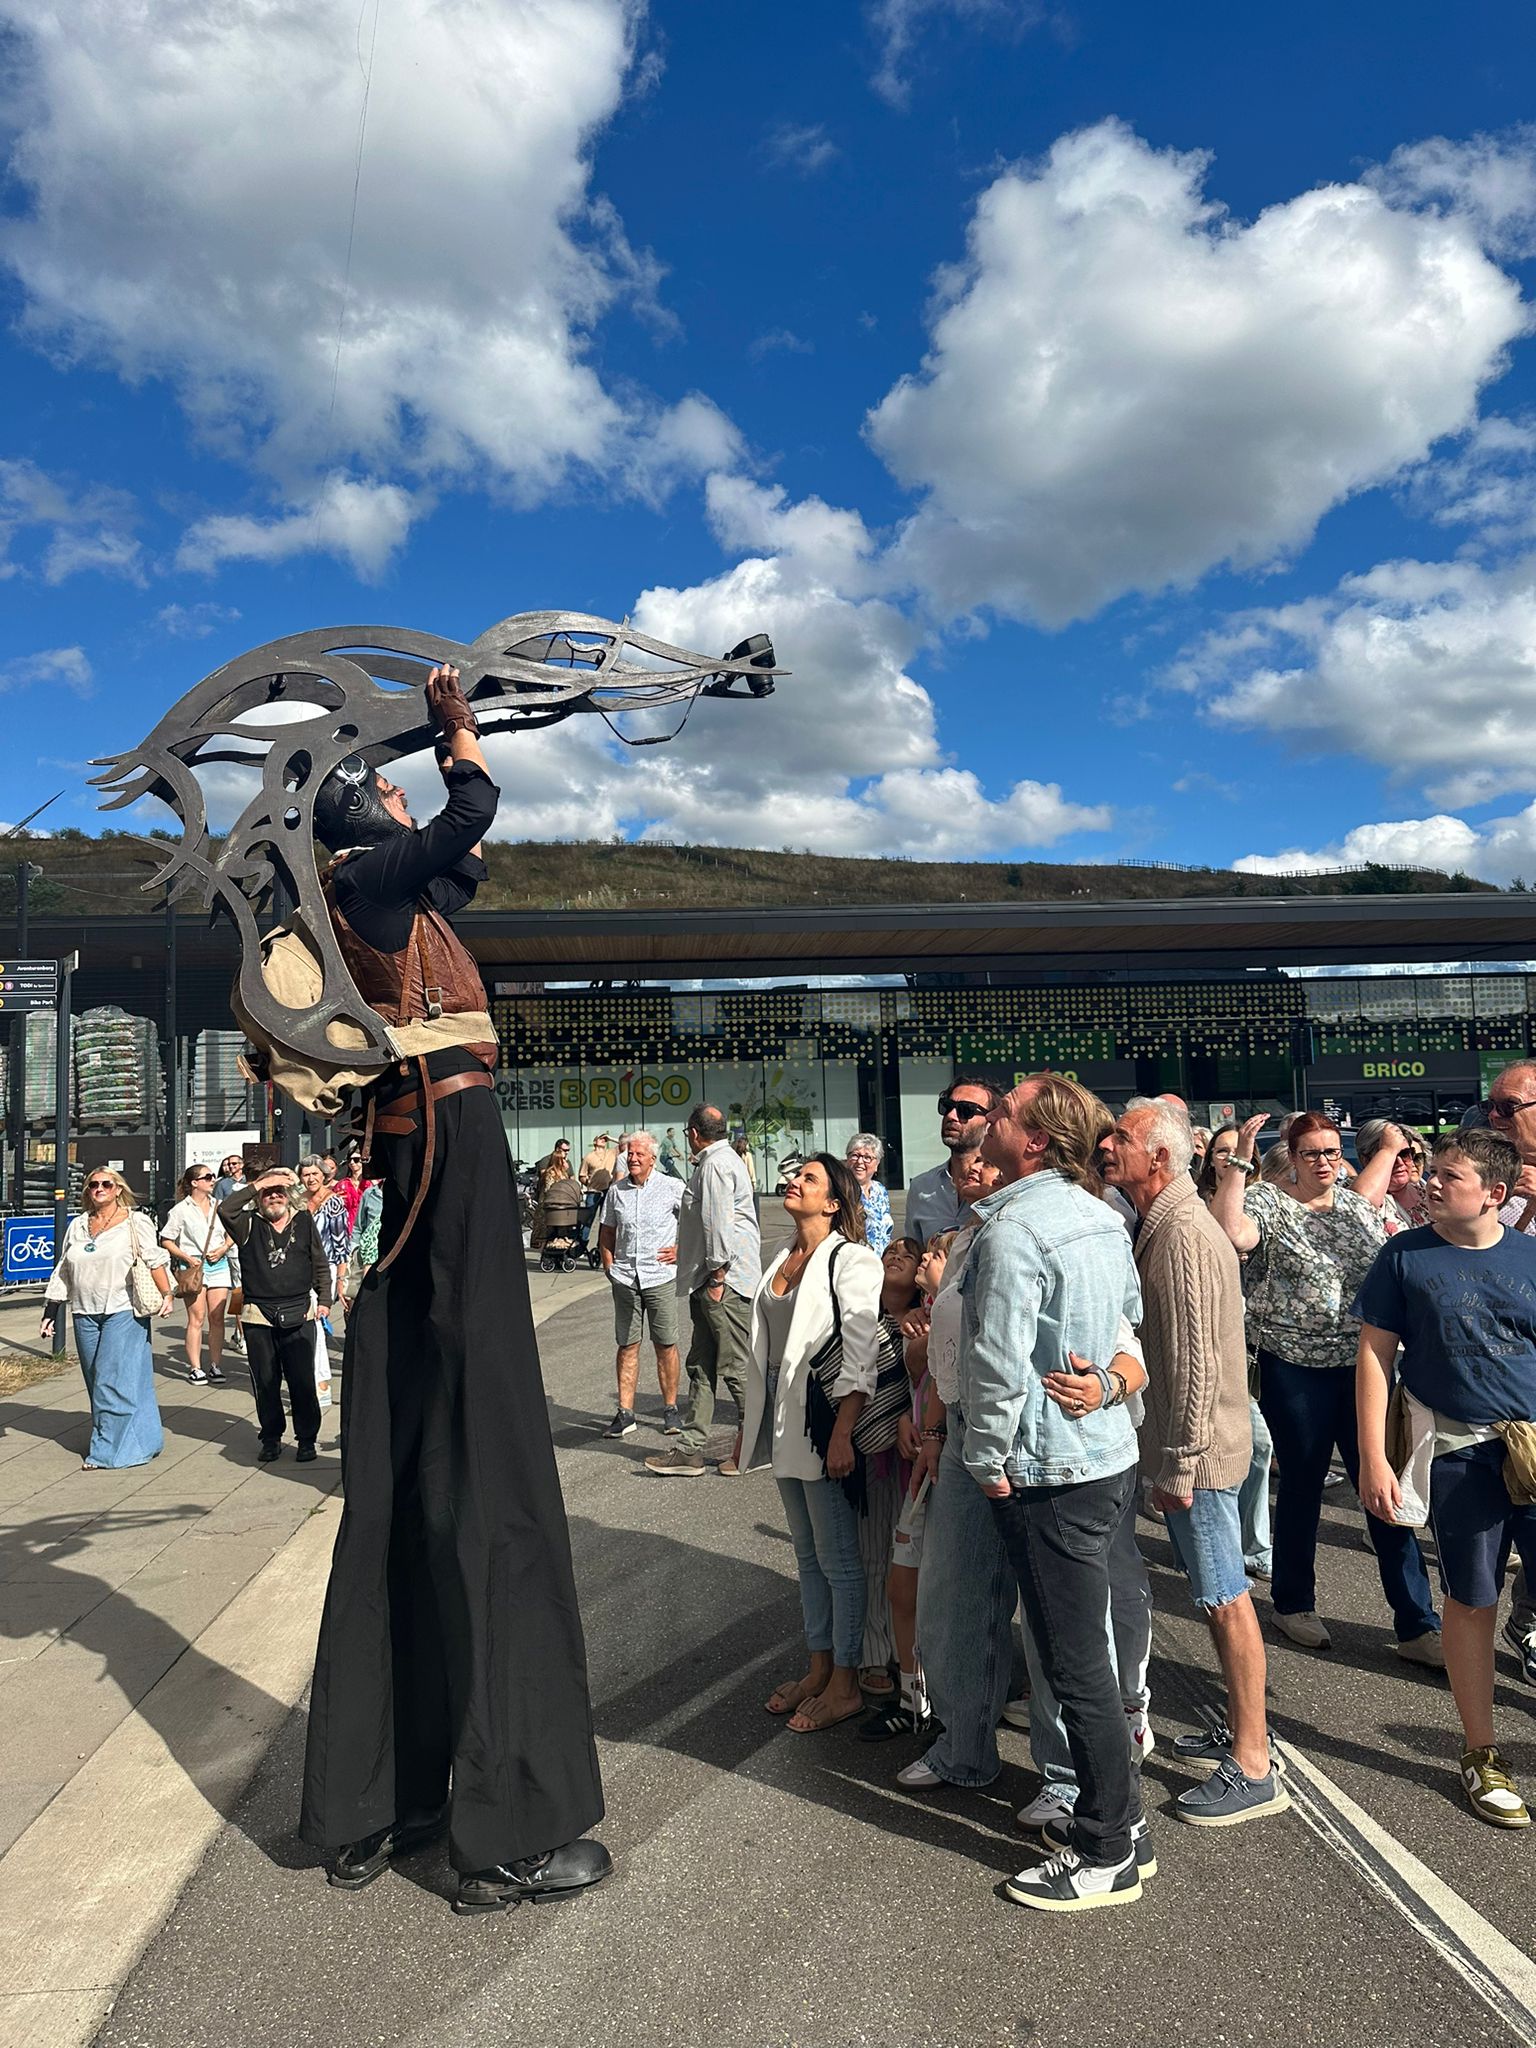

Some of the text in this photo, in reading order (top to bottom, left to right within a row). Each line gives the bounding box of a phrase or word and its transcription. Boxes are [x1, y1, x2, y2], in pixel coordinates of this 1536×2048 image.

[496, 1080, 524, 1096] OR
[529, 1080, 555, 1095] DE
[501, 1095, 555, 1111] KERS
